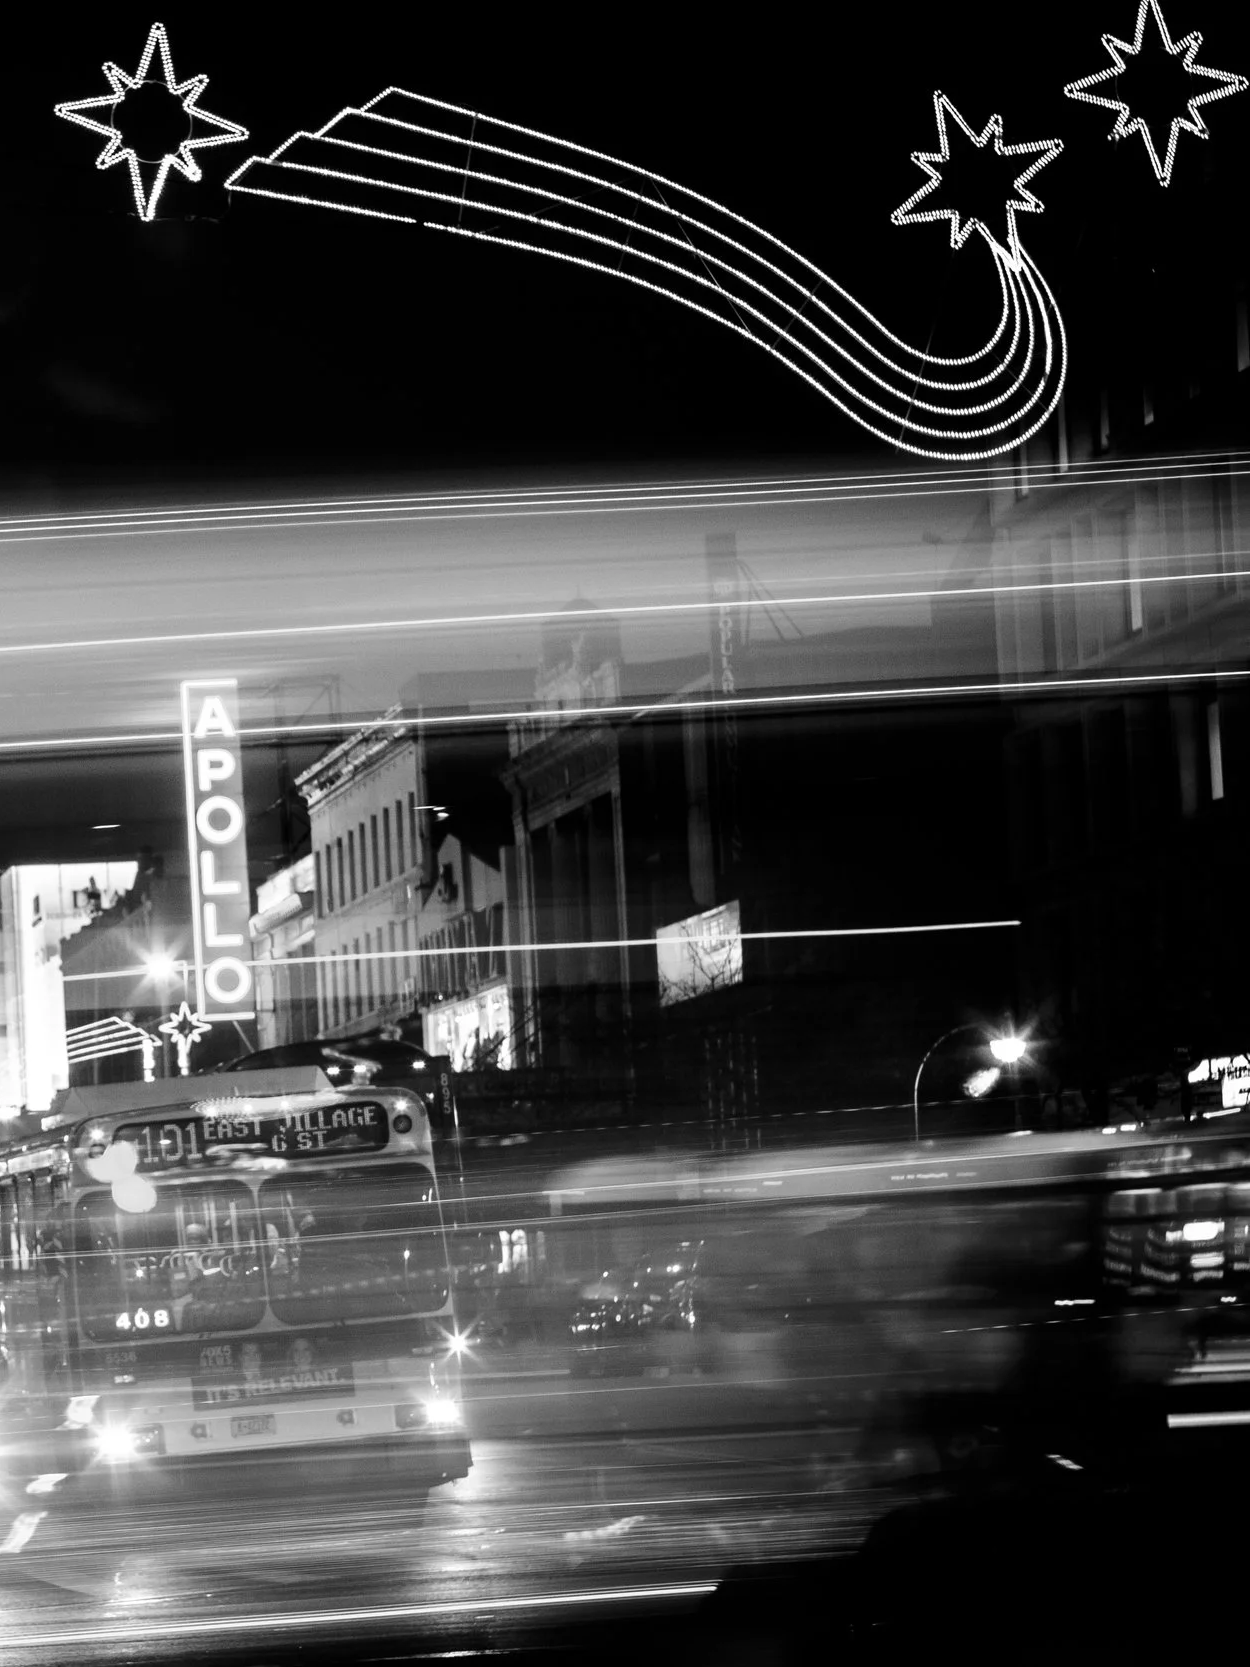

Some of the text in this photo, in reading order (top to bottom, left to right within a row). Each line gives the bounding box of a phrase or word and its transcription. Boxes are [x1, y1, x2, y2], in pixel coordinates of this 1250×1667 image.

[193, 695, 252, 1004] APOLLO
[202, 1117, 263, 1141] EAST
[295, 1129, 328, 1150] ST
[115, 1307, 170, 1330] 408
